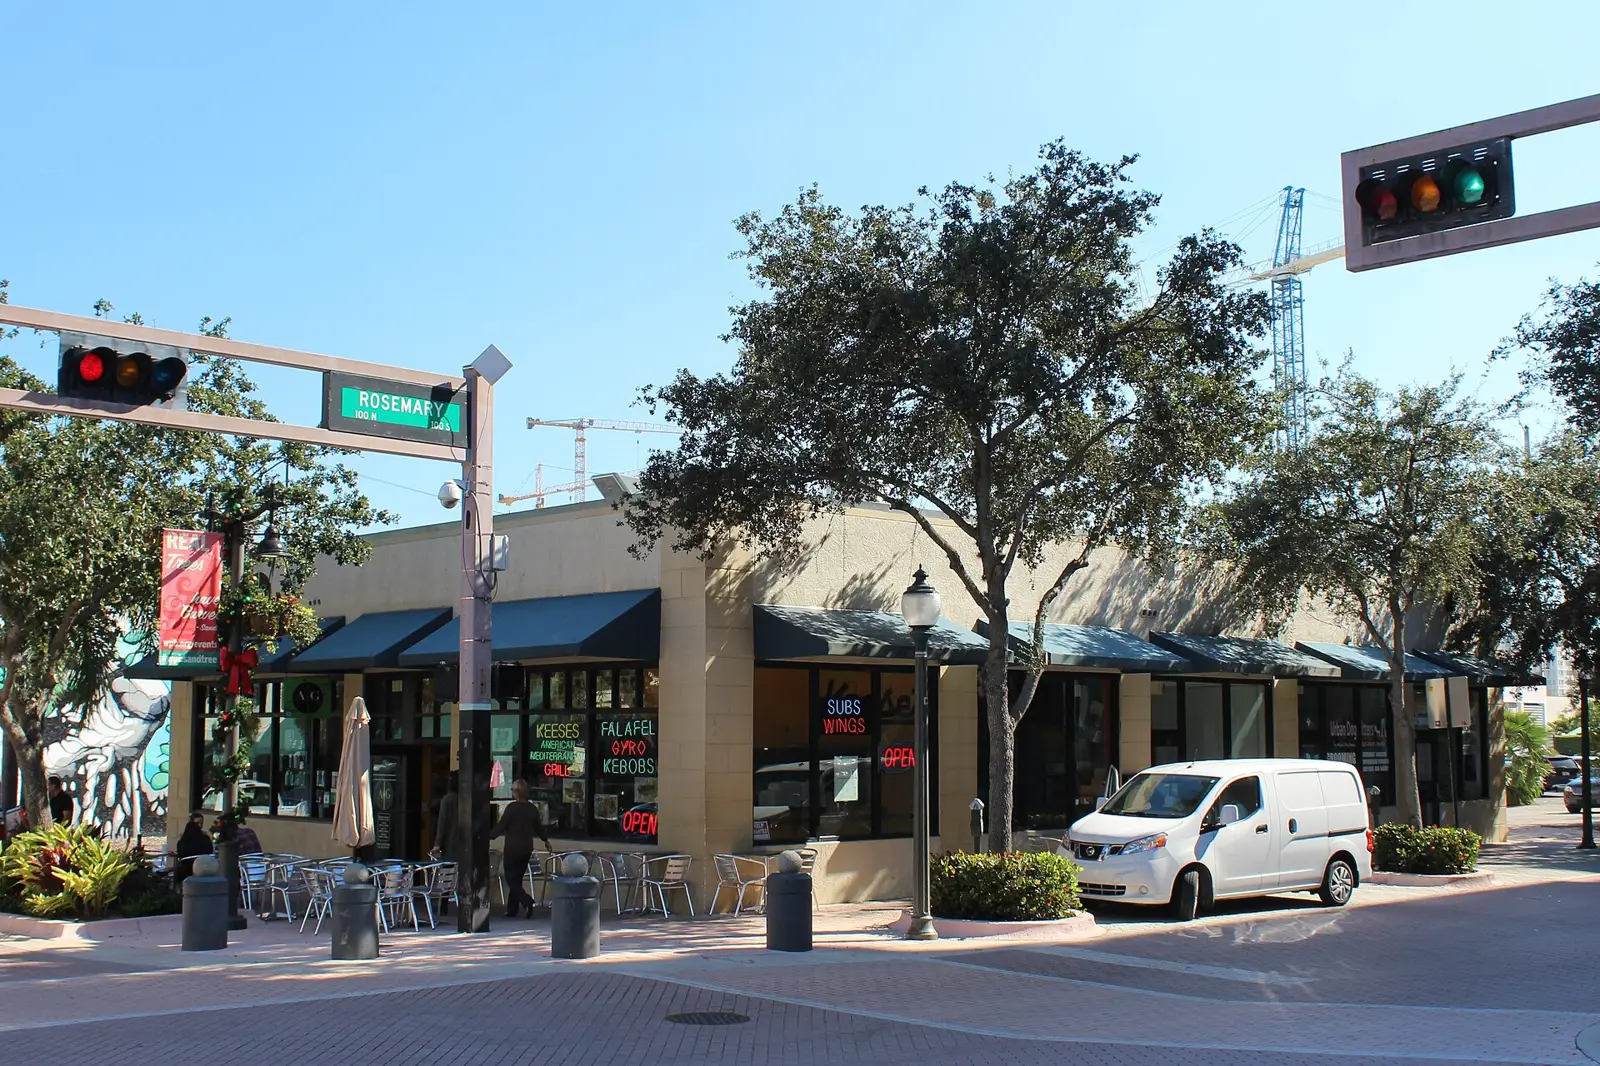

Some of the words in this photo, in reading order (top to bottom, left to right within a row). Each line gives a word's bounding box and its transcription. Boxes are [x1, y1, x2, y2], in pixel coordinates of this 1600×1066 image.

[359, 391, 444, 418] ROSEMARY
[354, 410, 369, 420] 100
[371, 412, 377, 421] N
[430, 421, 444, 430] 100
[166, 531, 209, 551] REAL
[166, 553, 205, 571] Trees
[189, 591, 220, 605] have
[827, 698, 861, 715] SUBS
[536, 723, 580, 739] KEESES
[601, 719, 656, 737] FALAFEL
[823, 717, 866, 735] WINGS
[540, 740, 576, 750] AMERICAN
[611, 740, 647, 756] GYRO
[603, 757, 655, 775] KEBOBS
[884, 747, 916, 768] OPEN
[543, 762, 571, 777] GRILL
[623, 811, 658, 836] OPEN
